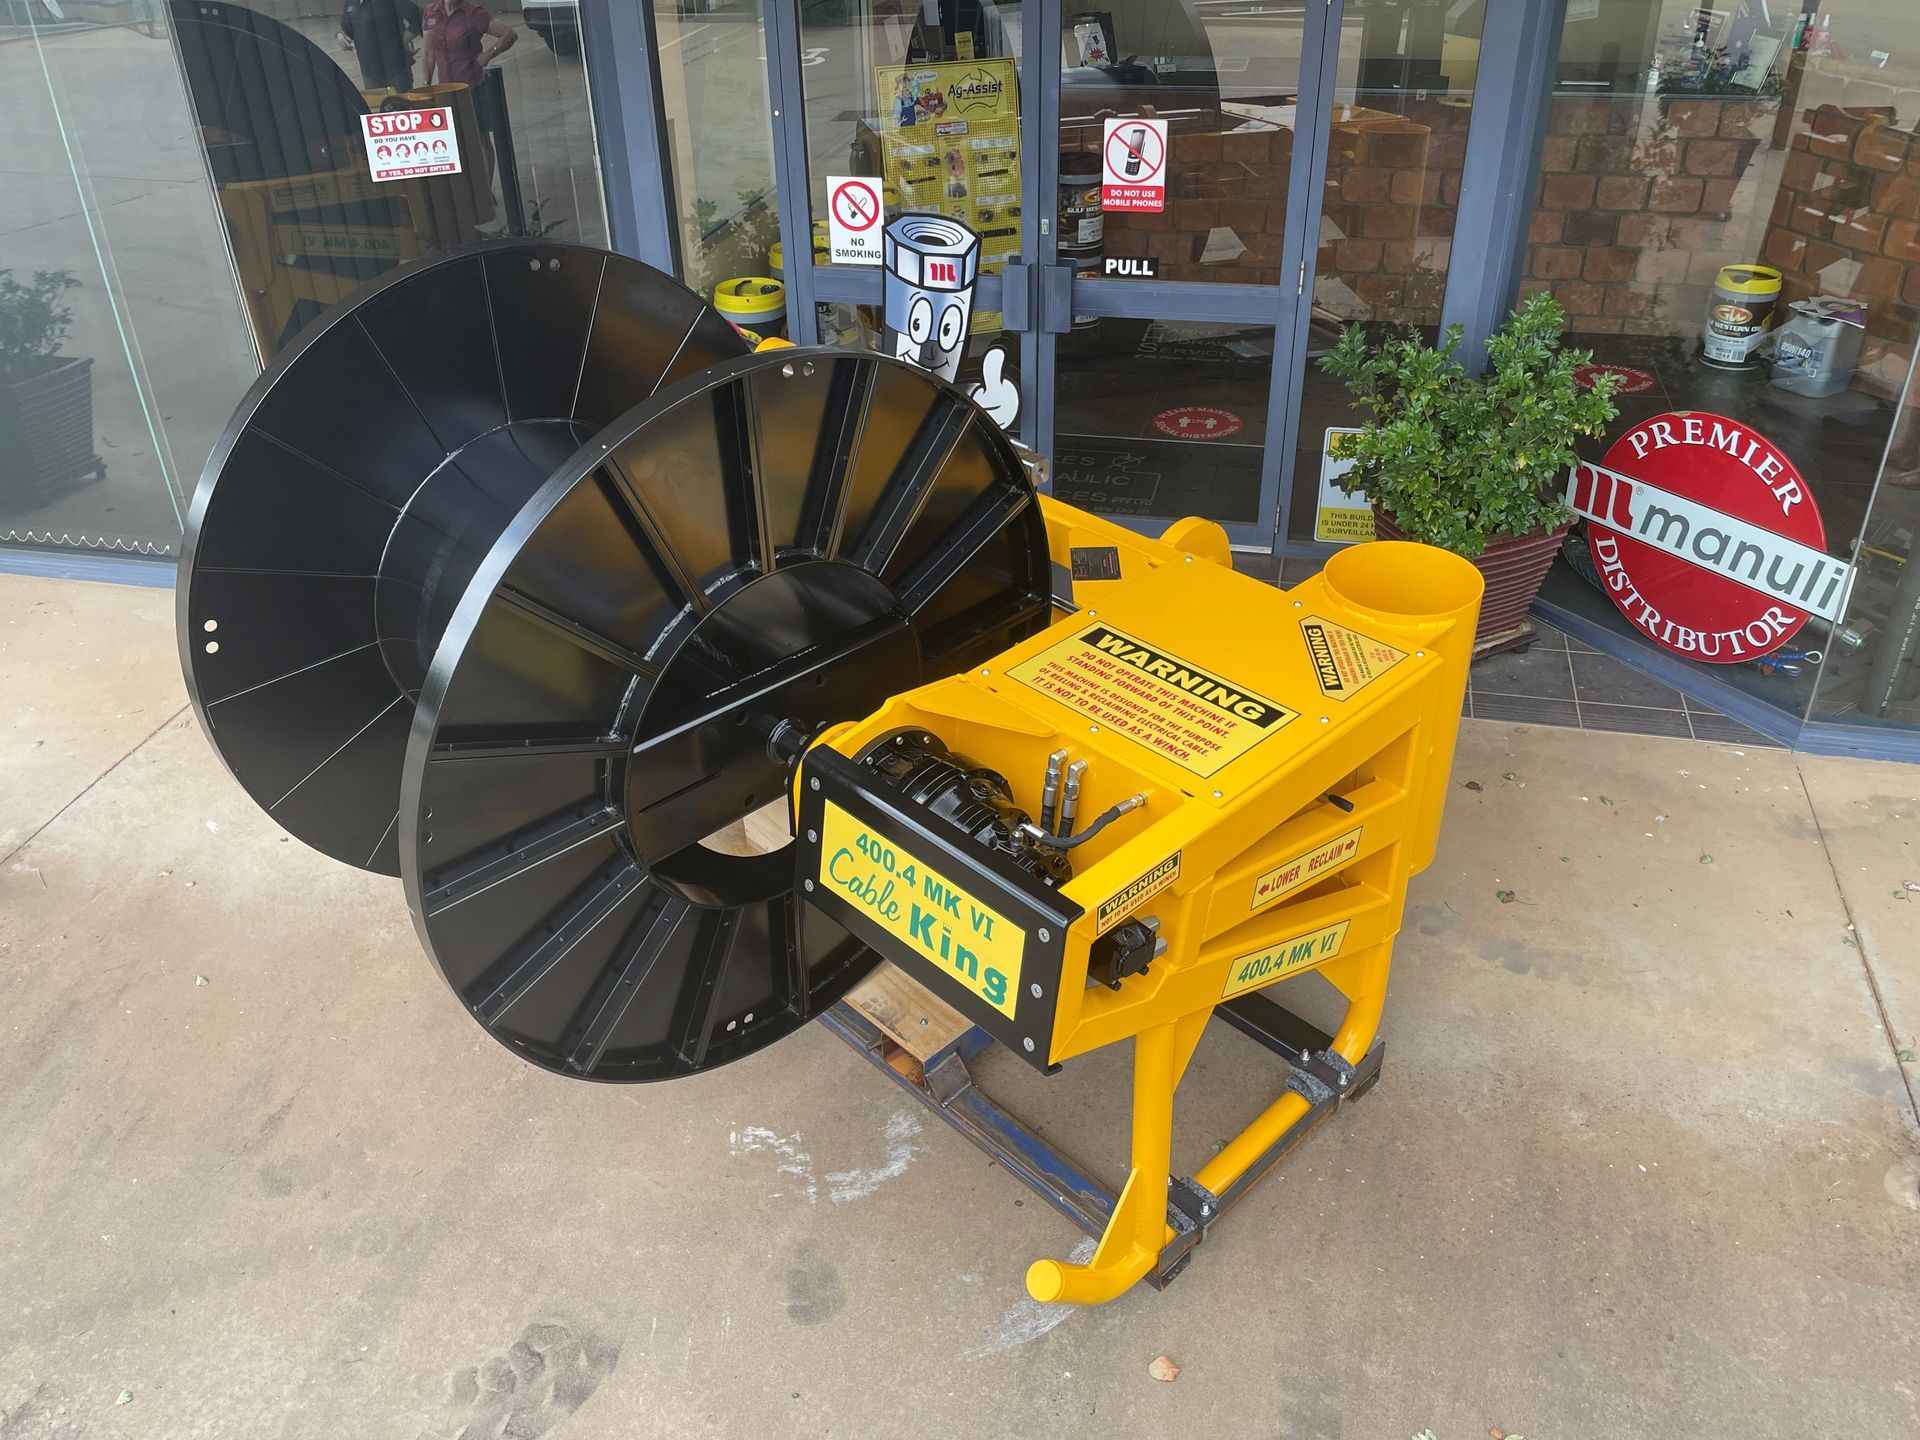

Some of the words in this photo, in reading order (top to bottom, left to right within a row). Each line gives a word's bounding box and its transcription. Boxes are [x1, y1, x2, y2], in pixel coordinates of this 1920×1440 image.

[948, 80, 1002, 98] Ag-Assist
[371, 114, 422, 134] STOP
[1124, 190, 1140, 198] NOT
[1142, 190, 1156, 198] USE
[1132, 200, 1162, 208] PHONES
[836, 249, 882, 259] SMOKING
[850, 238, 864, 246] NO
[1105, 258, 1154, 276] PULL
[1628, 419, 1802, 516] PREMIER
[1639, 504, 1845, 610] manuli
[1595, 536, 1796, 656] DISTRIBUTOR
[1096, 634, 1266, 720] WARNING
[1307, 627, 1340, 687] WARNING
[1034, 676, 1046, 684] IT
[1044, 682, 1056, 690] IS
[1054, 686, 1077, 700] NOT
[1075, 697, 1090, 708] TO
[1088, 704, 1104, 715] BE
[1102, 712, 1129, 728] USED
[1128, 725, 1144, 736] AS
[1142, 732, 1152, 741] A
[1152, 737, 1191, 761] WINCH.
[1039, 667, 1052, 675] OF
[1050, 672, 1082, 692] REELING
[1088, 692, 1136, 720] RECLAIMING
[1136, 716, 1182, 742] ELECTRICAL
[1182, 739, 1209, 757] CABLE.
[1047, 661, 1066, 673] THIS
[1064, 670, 1102, 691] MACHINE
[1109, 692, 1149, 715] DESIGNED
[1148, 712, 1166, 724] FOR
[1165, 720, 1184, 732] THE
[1182, 729, 1222, 752] PURPOSE
[1066, 655, 1112, 680] STANDING
[1112, 678, 1158, 704] FORWARD
[1158, 700, 1173, 710] OF
[1172, 707, 1197, 724] THIS
[1196, 718, 1230, 739] POINT.
[1081, 651, 1096, 660] DO
[1096, 658, 1117, 670] NOT
[1116, 668, 1157, 690] OPERATE
[1156, 687, 1179, 701] THIS
[1179, 698, 1226, 726] MACHINE
[1224, 720, 1238, 729] IF
[856, 833, 916, 888] 400.4
[924, 876, 962, 920] MK
[970, 906, 994, 942] VI
[1106, 860, 1174, 914] WARNING
[1270, 864, 1300, 892] LOWER
[1308, 843, 1344, 872] RECLAIM
[829, 848, 900, 922] Cable
[909, 902, 1008, 1006] King
[1102, 916, 1112, 928] NOT
[1114, 910, 1120, 918] TO
[1145, 888, 1152, 896] AS
[1238, 950, 1286, 982] 400.4
[1287, 939, 1317, 966] MK
[1320, 932, 1337, 954] VI
